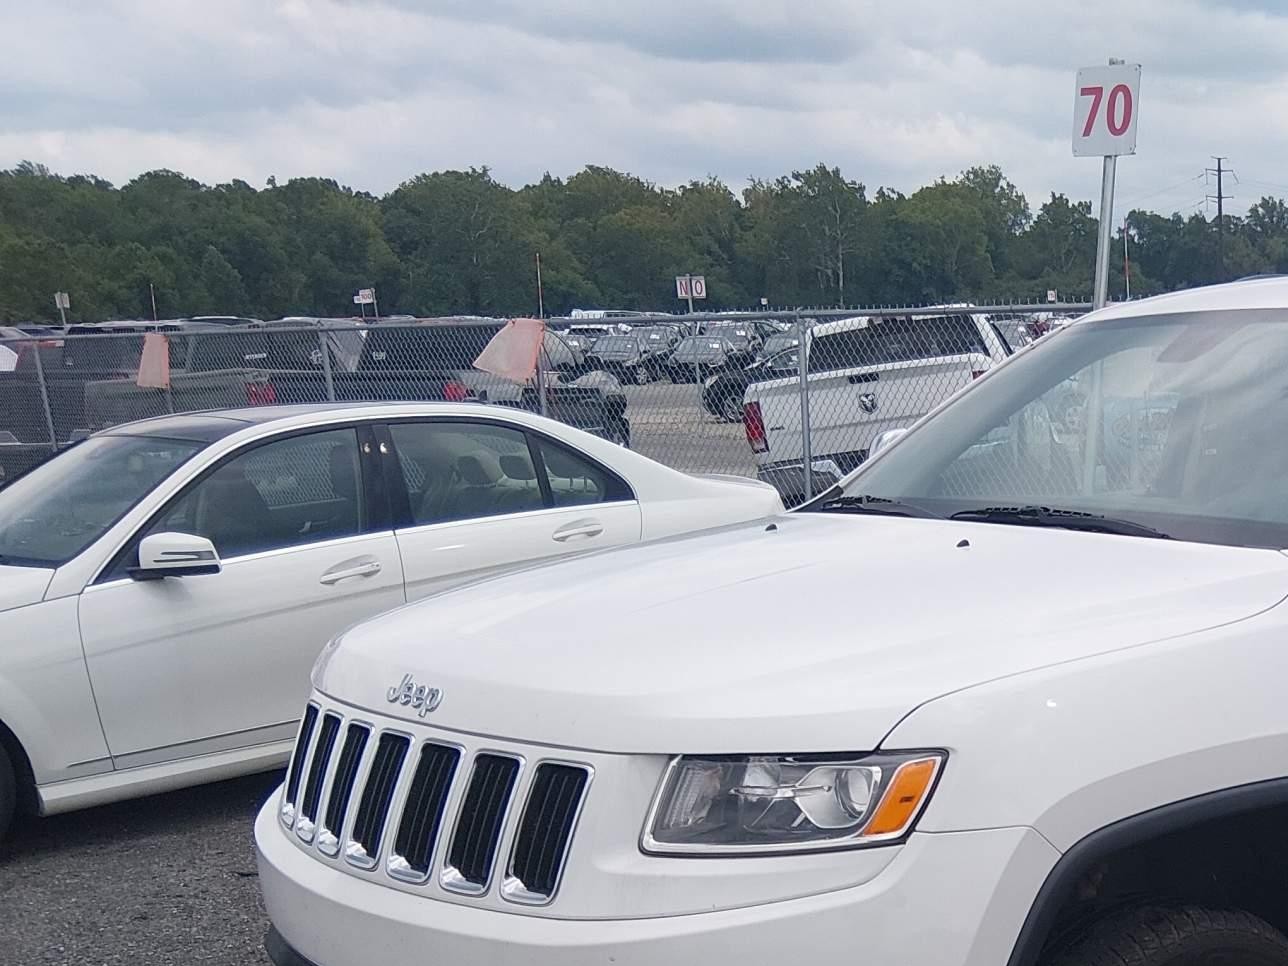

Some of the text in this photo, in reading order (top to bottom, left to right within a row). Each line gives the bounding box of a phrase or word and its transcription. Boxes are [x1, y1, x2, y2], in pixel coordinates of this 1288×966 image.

[1080, 83, 1133, 137] 70
[679, 280, 689, 296] N
[386, 673, 444, 718] Jeep
